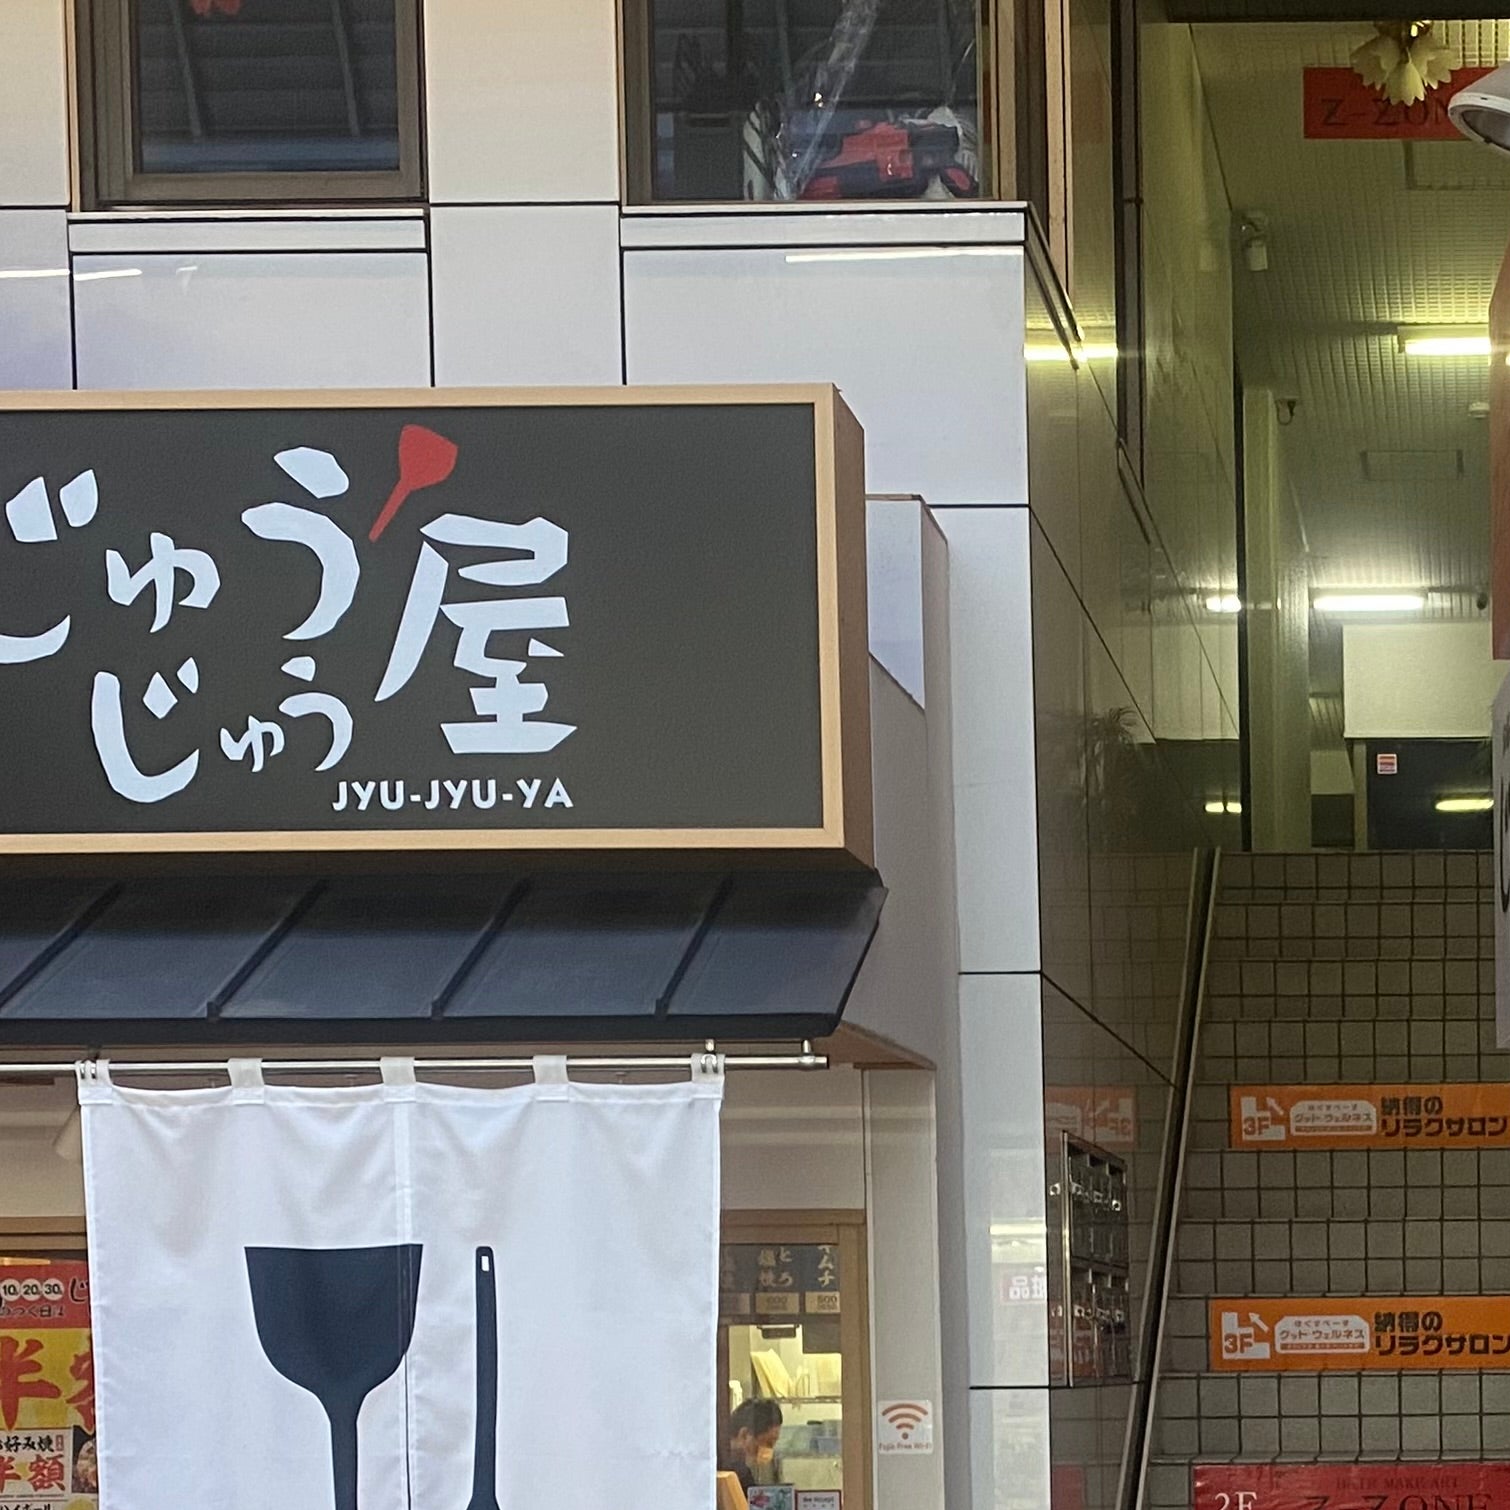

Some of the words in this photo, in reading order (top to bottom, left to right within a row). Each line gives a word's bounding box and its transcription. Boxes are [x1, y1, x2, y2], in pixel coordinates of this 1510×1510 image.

[332, 777, 574, 811] JYU-JYU-YA
[1381, 1096, 1443, 1115] 納得の
[1243, 1116, 1271, 1136] 3F
[1381, 1118, 1507, 1137] リラクサロン
[1374, 1311, 1442, 1332] 納得の
[1223, 1333, 1254, 1355] 3F
[0, 1435, 55, 1453] 好み焼
